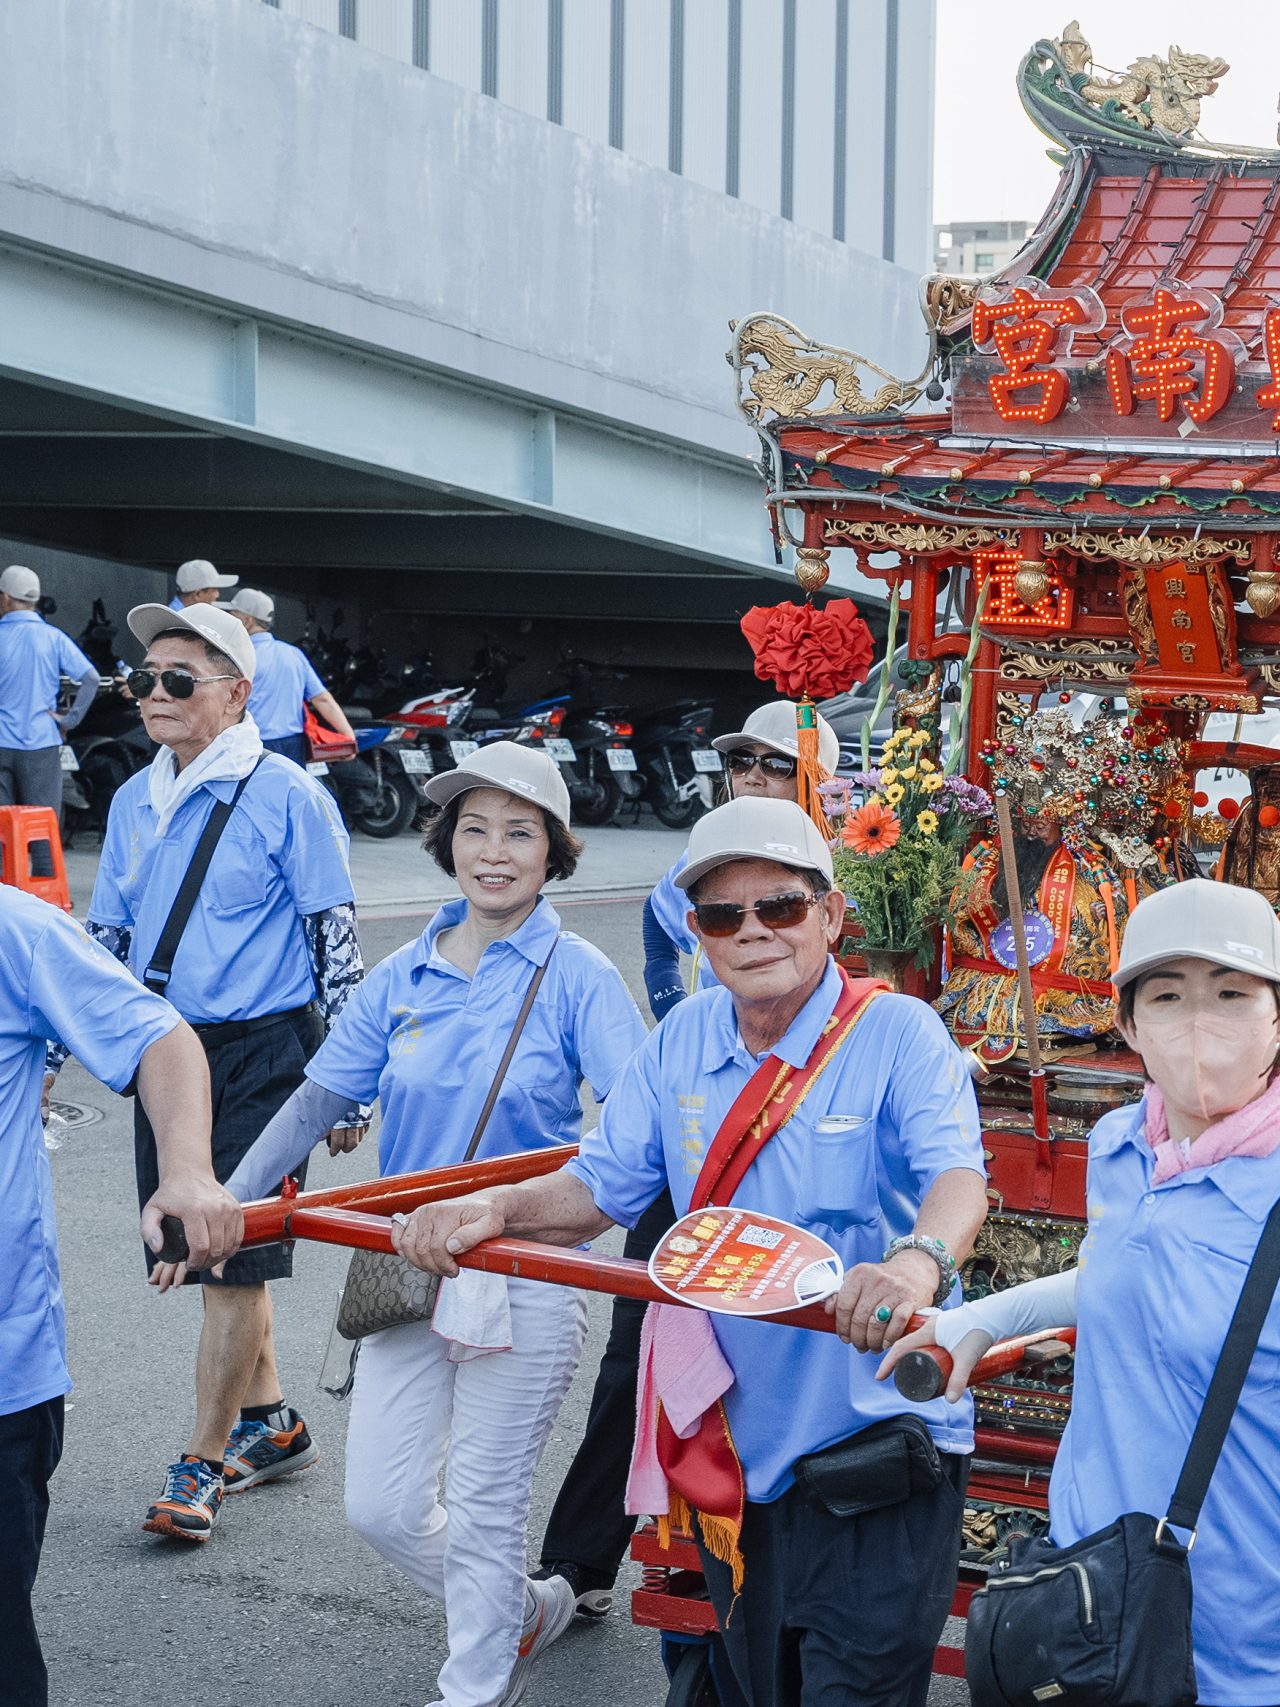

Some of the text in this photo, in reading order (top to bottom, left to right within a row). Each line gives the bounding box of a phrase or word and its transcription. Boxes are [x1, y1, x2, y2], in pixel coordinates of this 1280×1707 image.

[1165, 578, 1197, 663] 興南宮
[721, 1252, 767, 1302] 0936-040-836
